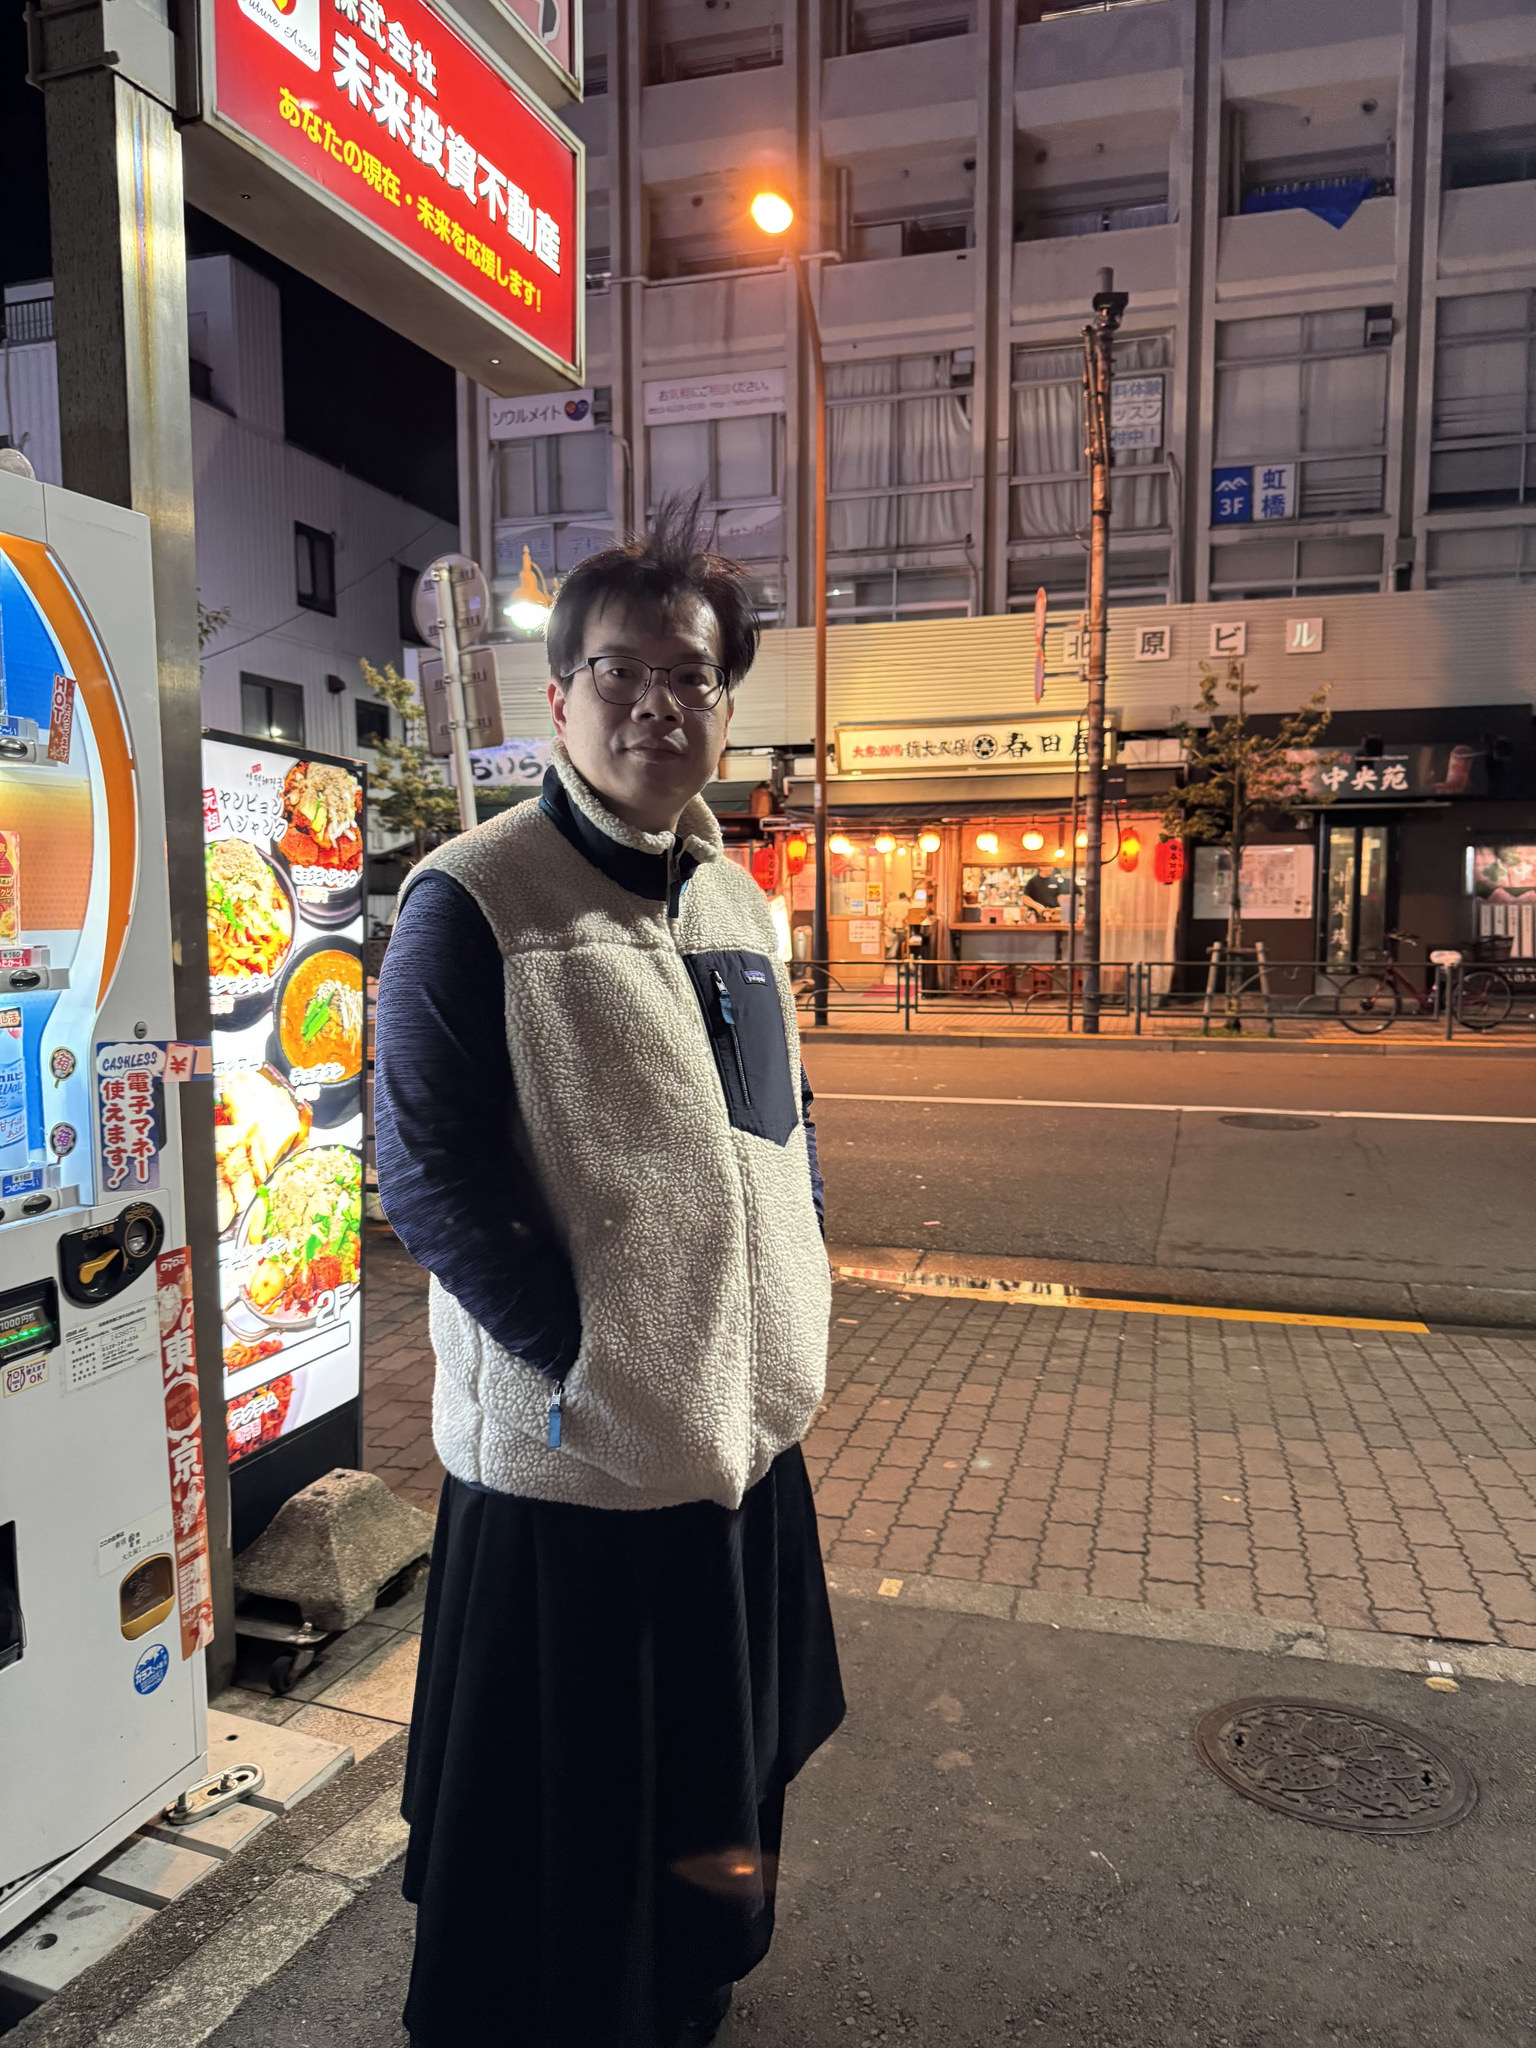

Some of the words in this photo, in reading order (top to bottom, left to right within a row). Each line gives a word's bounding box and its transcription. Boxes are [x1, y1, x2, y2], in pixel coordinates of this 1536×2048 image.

[243, 0, 280, 28] uture
[333, 30, 561, 276] 未来投資不動産
[493, 405, 562, 426] ソウルメイト
[1219, 498, 1245, 516] 3F
[1262, 468, 1286, 518] 虹橋
[53, 674, 67, 723] HOT
[1321, 764, 1409, 792] 中央苑
[103, 1051, 158, 1071] CASHLESS
[103, 1080, 127, 1186] 使えます!
[127, 1072, 152, 1179] 電子マネー
[160, 1258, 186, 1272] DyDo
[316, 1283, 351, 1328] 2F
[30, 1371, 43, 1384] OK
